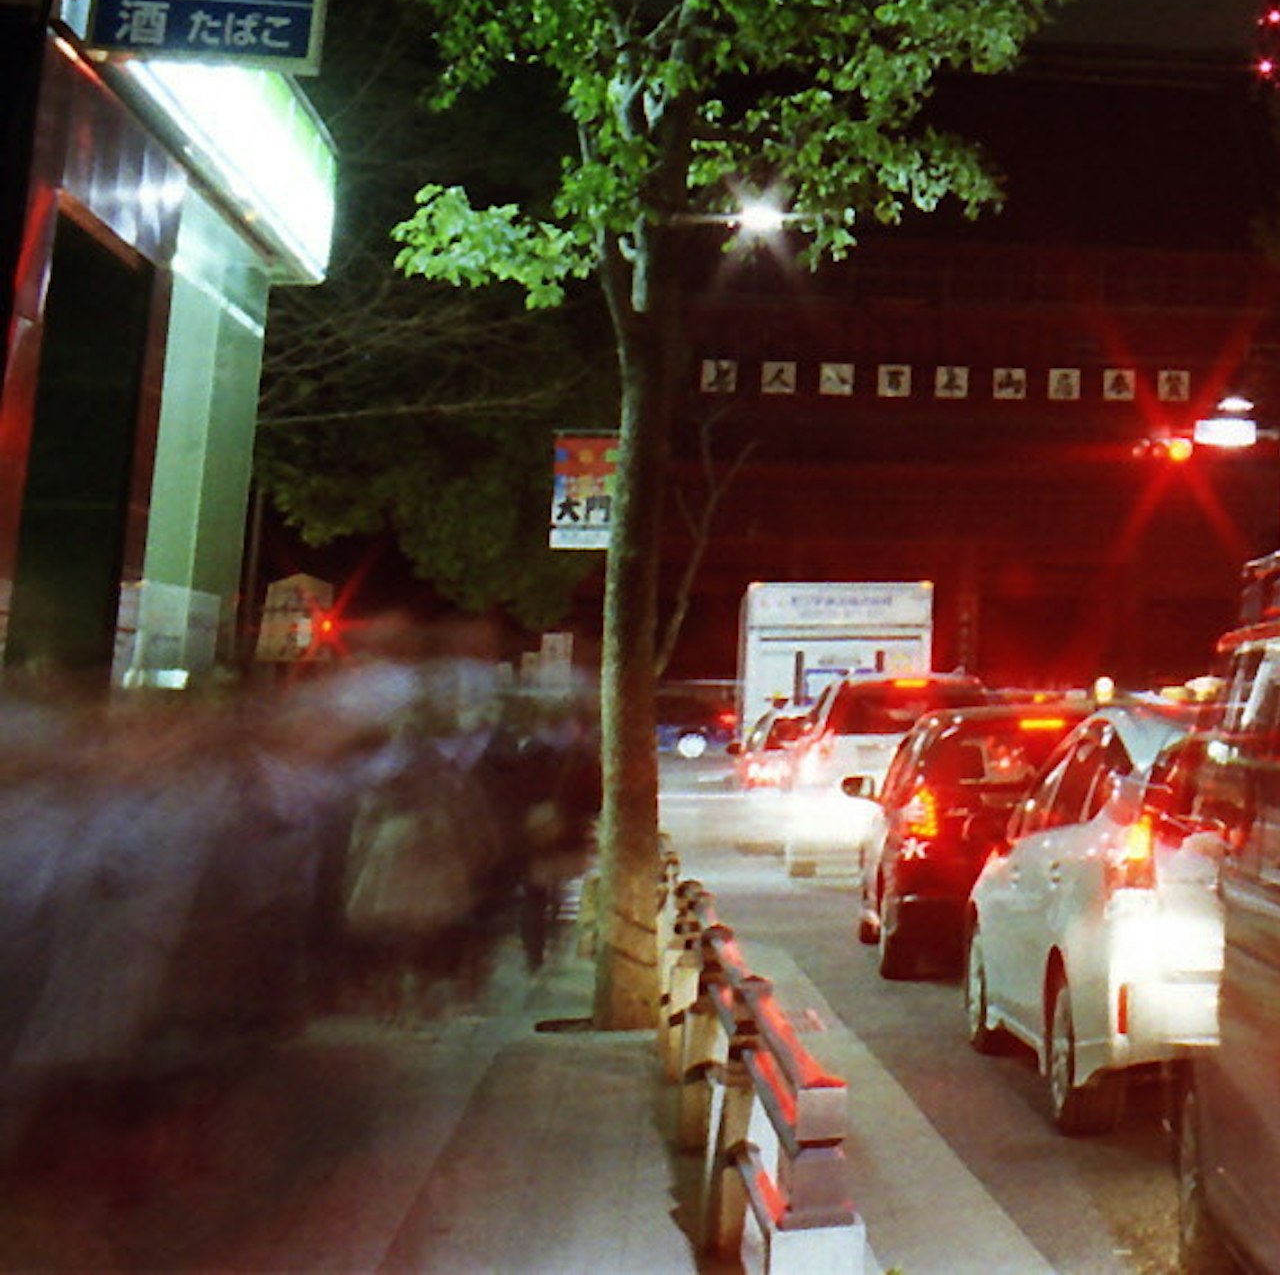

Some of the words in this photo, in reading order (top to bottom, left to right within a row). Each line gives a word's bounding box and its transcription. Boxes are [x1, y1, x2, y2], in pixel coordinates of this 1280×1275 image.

[114, 0, 171, 45] 酒
[187, 8, 292, 49] たばこ
[556, 495, 612, 523] 大門
